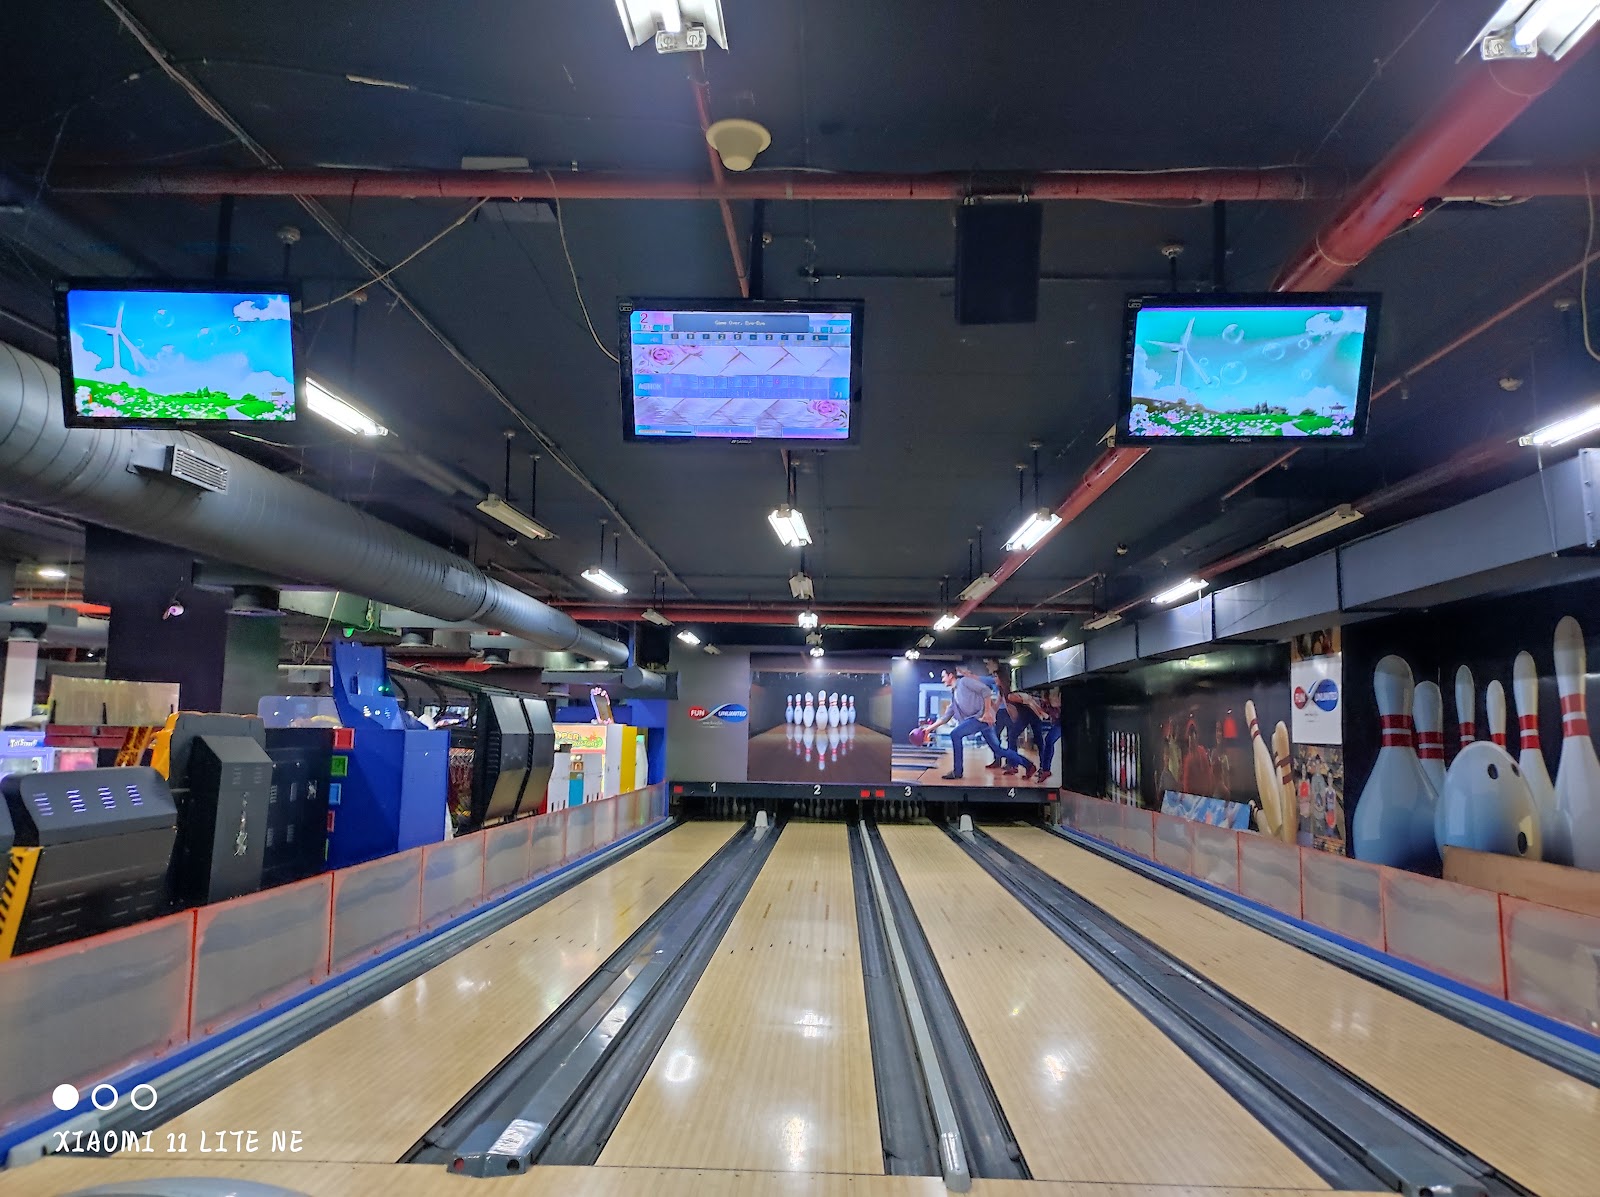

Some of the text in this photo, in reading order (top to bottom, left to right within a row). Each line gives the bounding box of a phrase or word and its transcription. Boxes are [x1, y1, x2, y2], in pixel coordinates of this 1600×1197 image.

[640, 313, 648, 323] 2
[690, 709, 705, 717] FUN
[710, 782, 1016, 798] 1 2 3 4
